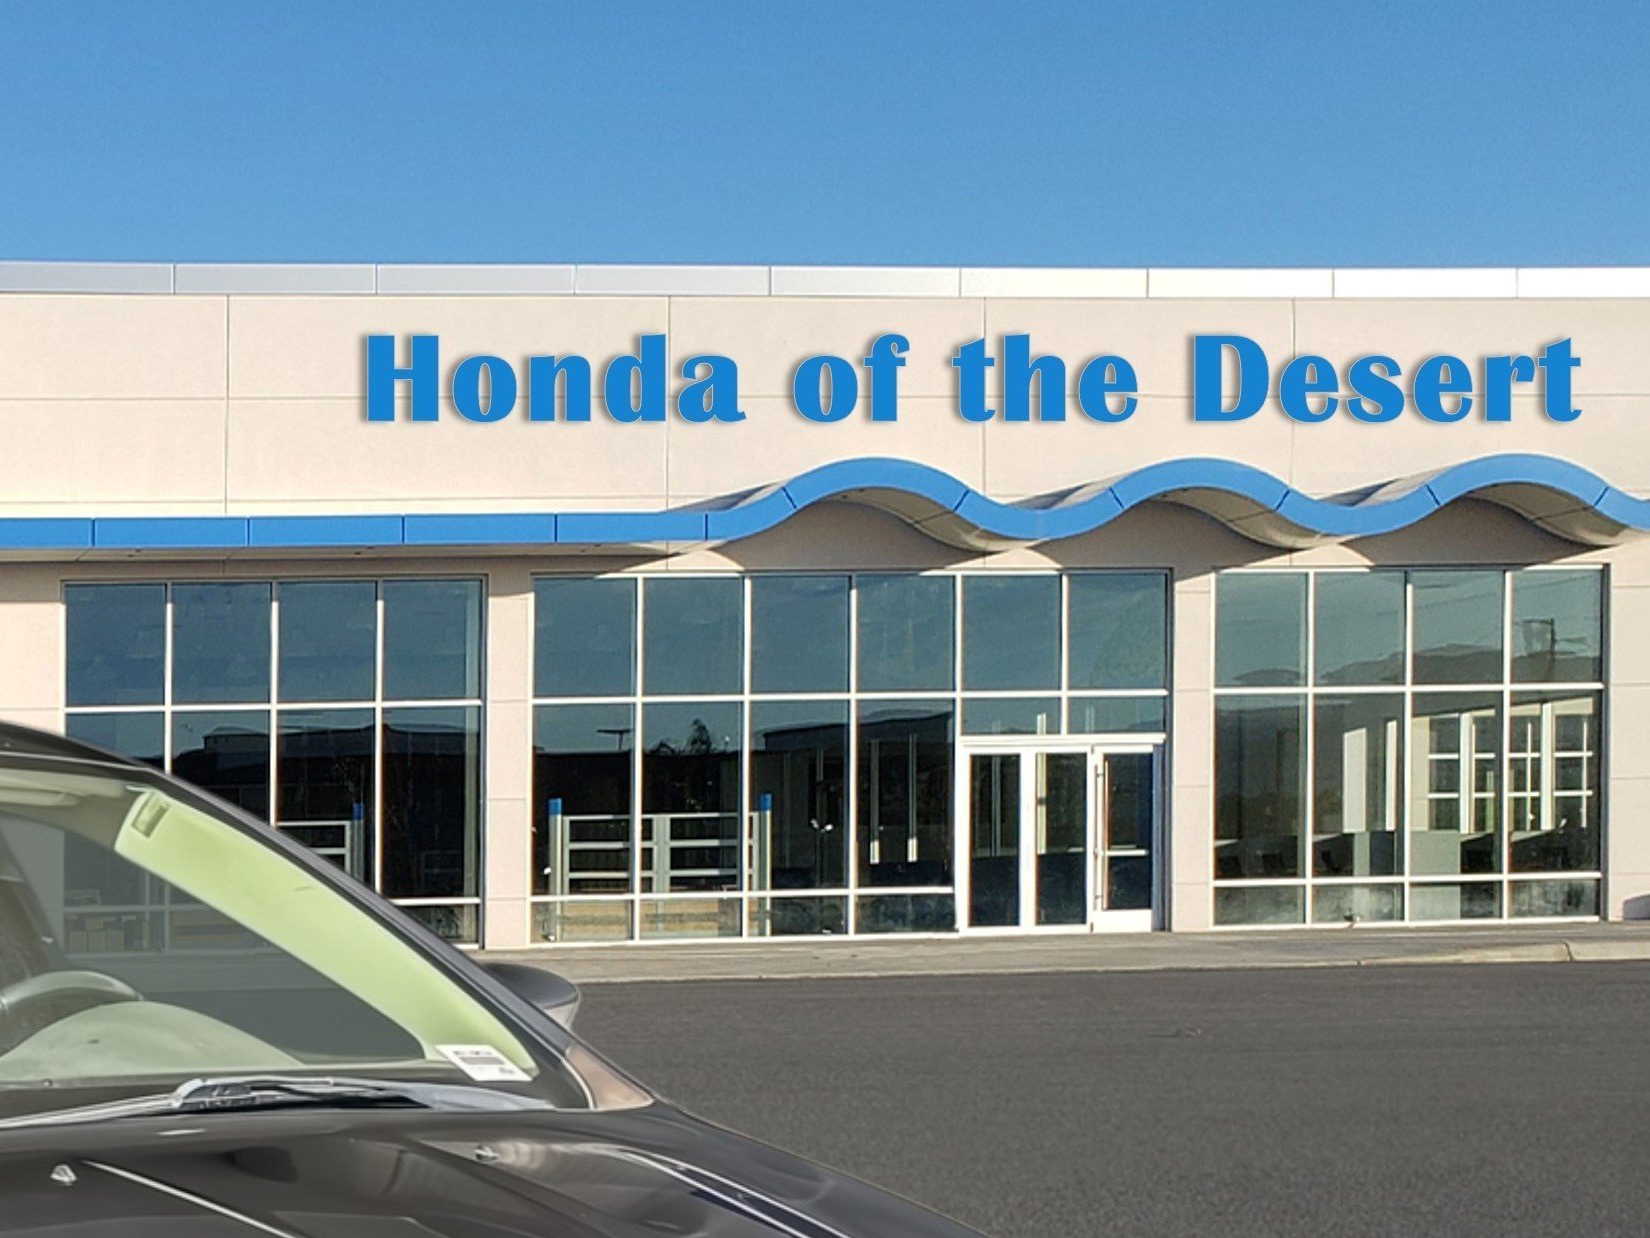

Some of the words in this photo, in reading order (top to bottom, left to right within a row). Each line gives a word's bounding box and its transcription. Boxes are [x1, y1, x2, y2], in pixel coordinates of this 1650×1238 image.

[366, 333, 748, 424] Honda
[793, 333, 911, 424] of
[951, 333, 1138, 424] the
[1194, 334, 1583, 424] Desert
